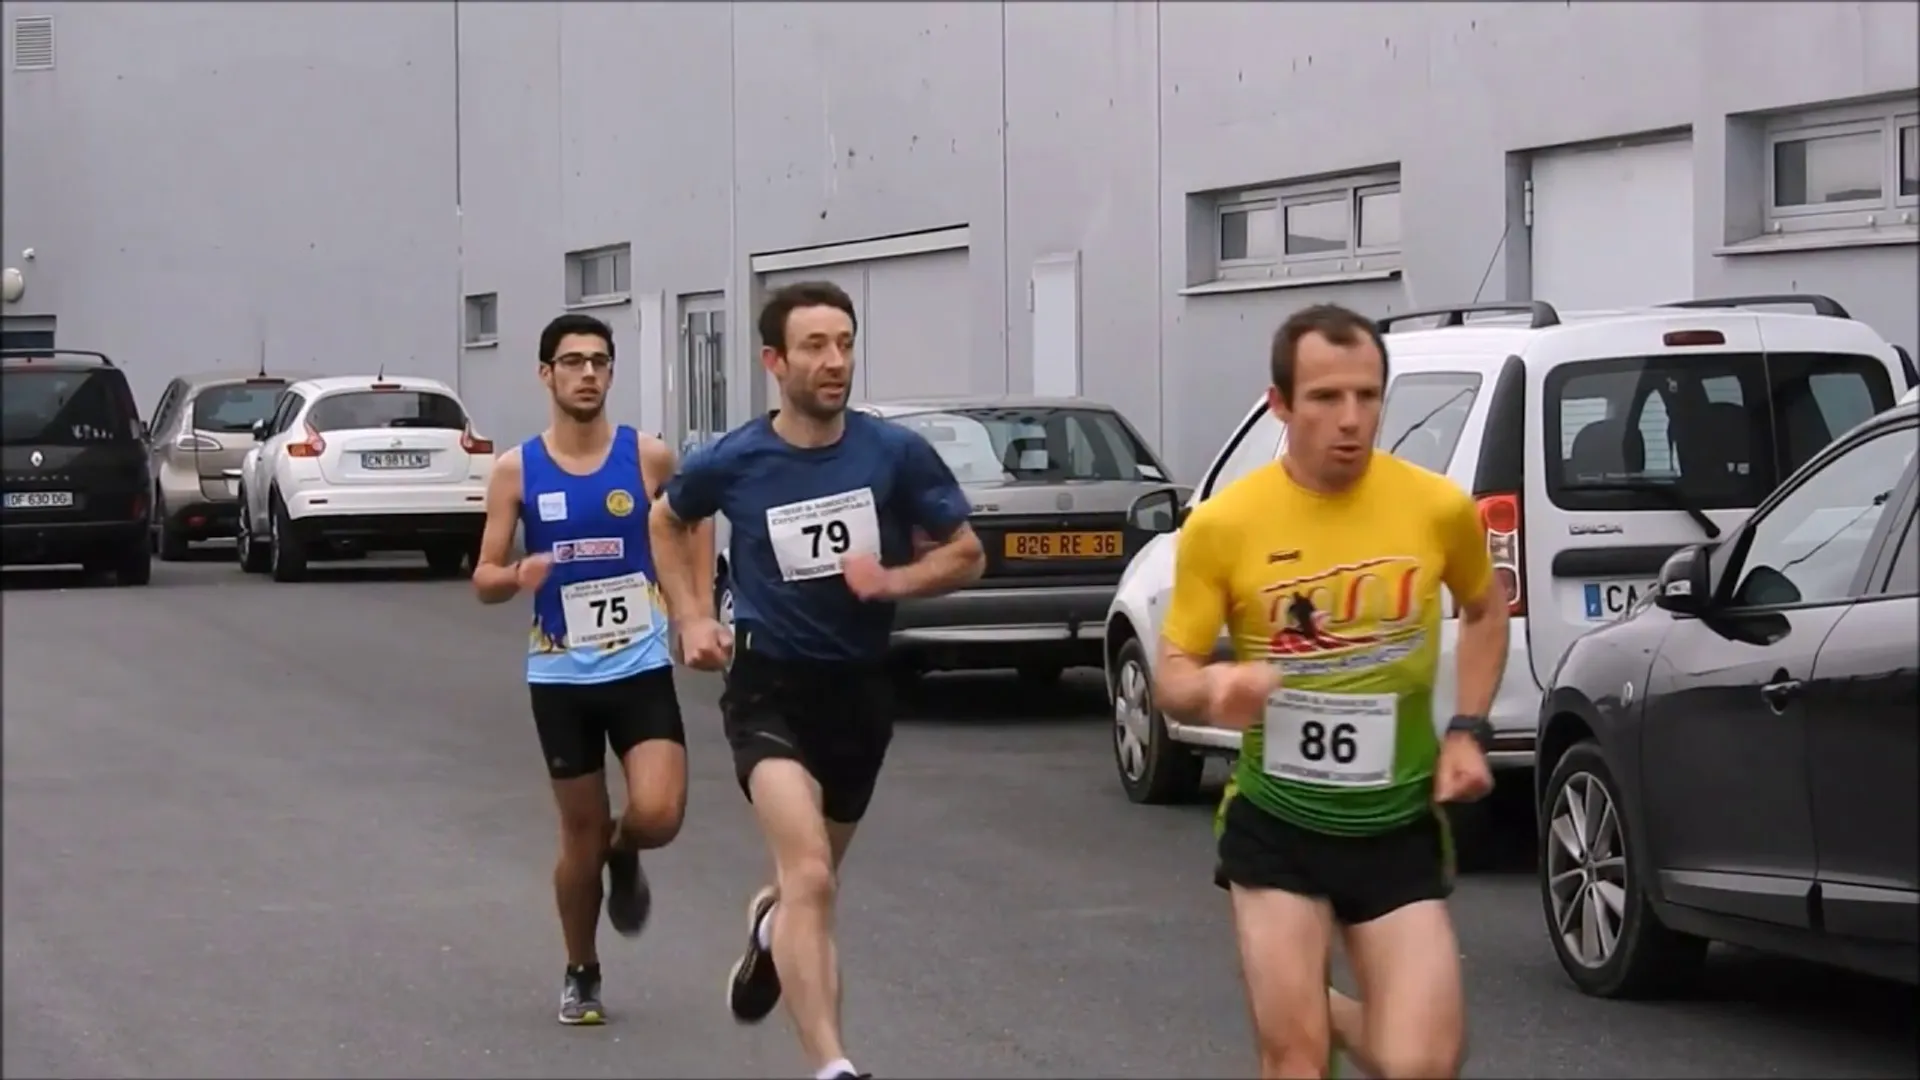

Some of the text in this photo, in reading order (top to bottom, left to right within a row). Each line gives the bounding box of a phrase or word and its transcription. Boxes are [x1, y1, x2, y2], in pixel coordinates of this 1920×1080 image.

[801, 520, 850, 559] 79
[1016, 534, 1115, 554] 826 RE 36
[589, 596, 628, 628] 75
[1299, 720, 1357, 764] 86
